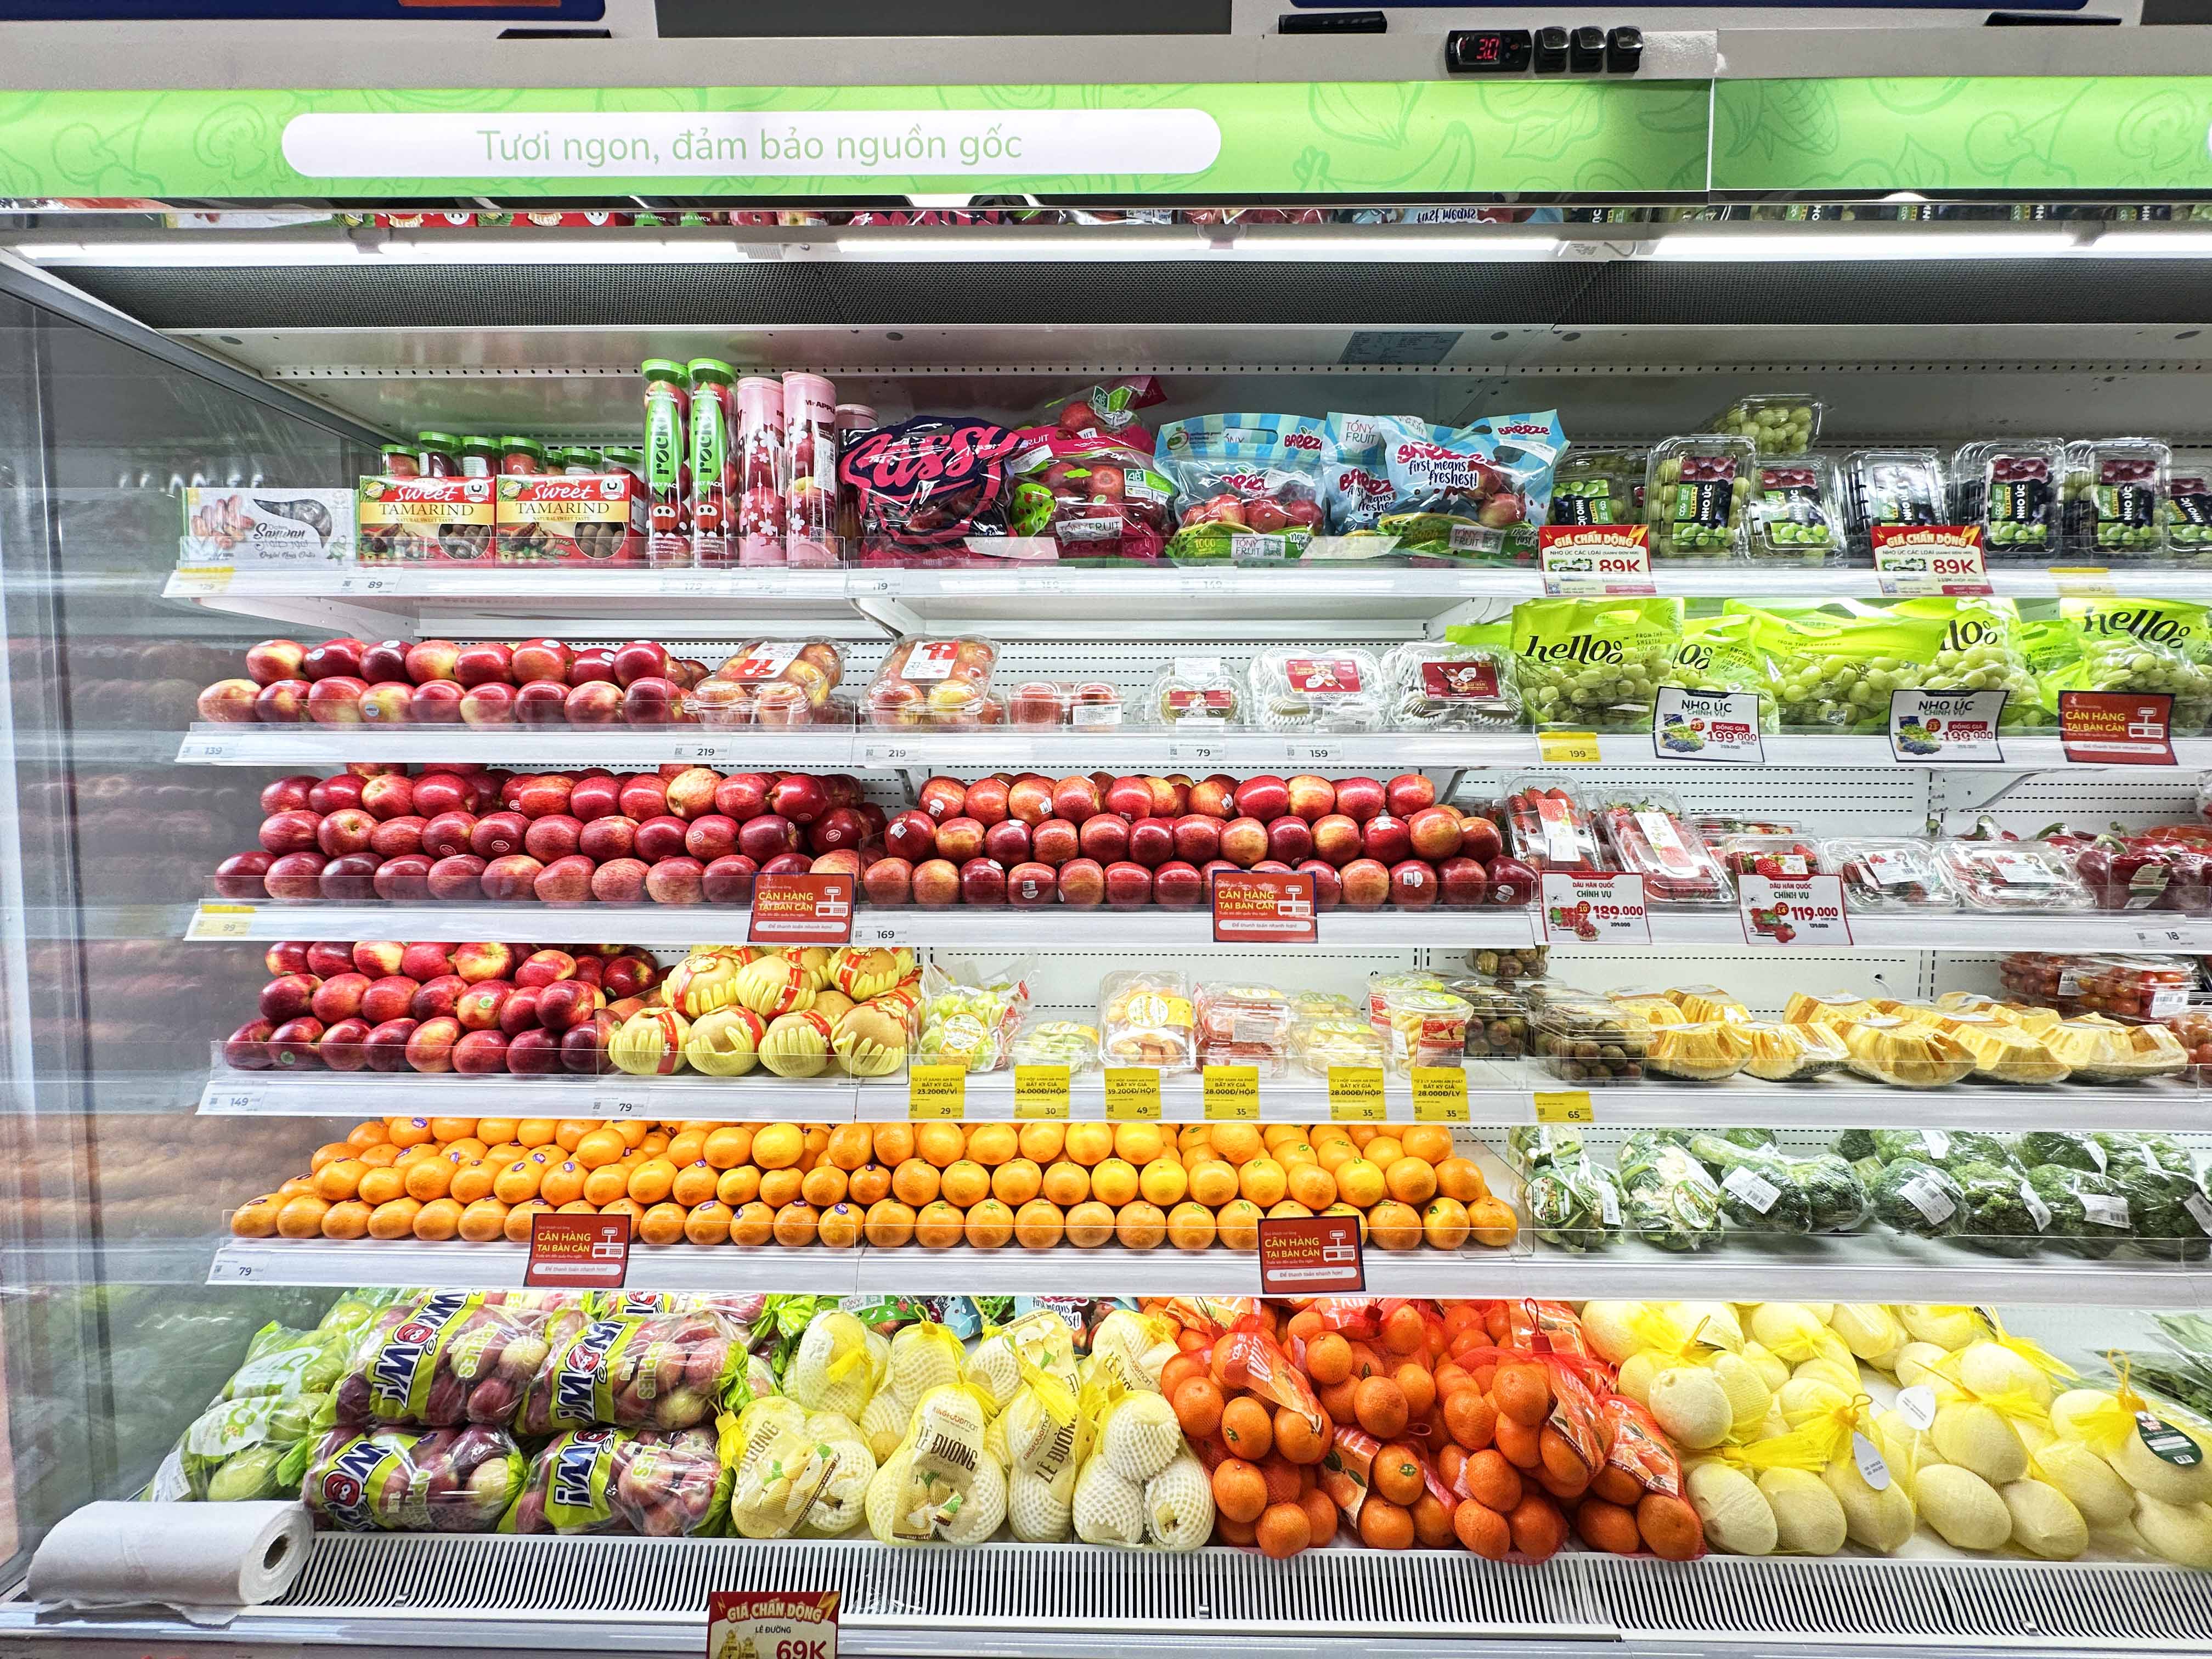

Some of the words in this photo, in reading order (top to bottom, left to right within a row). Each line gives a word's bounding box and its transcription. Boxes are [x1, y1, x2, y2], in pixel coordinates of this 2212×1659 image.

[477, 129, 551, 161] Tươi
[564, 132, 661, 168] ngon,
[672, 127, 748, 161] đảm
[760, 127, 823, 161] bảo
[837, 123, 946, 167] nguồn
[958, 122, 1022, 166] gốc
[1346, 420, 1375, 433] TÓNY
[1346, 432, 1375, 444] FRUIT
[1408, 459, 1431, 476] first
[1434, 460, 1467, 472] means
[1428, 470, 1478, 487] freshest!
[1701, 484, 1713, 499] ÚC
[2015, 484, 2025, 498] ÚC
[2123, 485, 2133, 499] ÚC
[379, 504, 475, 516] TAMARIND
[515, 502, 610, 515] TAMARIND
[1575, 499, 1584, 515] NHO
[1701, 500, 1710, 521] NHO
[2016, 498, 2025, 519] NHO
[2124, 499, 2133, 521] NHO
[1454, 537, 1480, 547] FRUIT
[1554, 533, 1573, 548] GIÁ
[1574, 531, 1603, 546] CHẤN
[1603, 532, 1634, 548] ĐỘNG
[1886, 532, 1906, 548] GIÁ
[1906, 529, 1936, 545] CHẤN
[1936, 532, 1967, 548] ĐỘNG
[1235, 548, 1260, 556] FRUIT
[1599, 558, 1640, 572] 89K
[1932, 558, 1977, 575] 89K
[367, 581, 383, 589] 89
[1681, 699, 1710, 710] NHO
[1714, 699, 1733, 713] ÚC
[1918, 701, 1950, 711] NHO
[1954, 698, 1975, 711] ÚC
[2065, 709, 2089, 721] CÂN
[2092, 709, 2125, 721] HÀNG
[2083, 721, 2103, 731] BÀN
[2106, 723, 2125, 732] CÂN
[697, 747, 715, 757] 219
[888, 748, 907, 758] 219
[1196, 749, 1211, 758] 79
[1309, 749, 1329, 758] 159
[1568, 749, 1587, 759] 199
[758, 890, 781, 901] CÂN
[783, 890, 814, 901] HÀNG
[1218, 888, 1241, 899] CÂN
[1243, 888, 1274, 900] HÀNG
[1576, 889, 1600, 898] CHÍNH
[1601, 890, 1612, 899] VỤ
[1773, 890, 1797, 899] CHÍNH
[1798, 892, 1809, 900] VỤ
[1218, 902, 1233, 911] TẠI
[1235, 900, 1254, 910] BÀN
[1256, 901, 1274, 910] CÂN
[1593, 905, 1644, 920] 189.000
[1791, 906, 1838, 921] 119.000
[877, 930, 895, 939] 169
[2165, 932, 2180, 941] 18
[229, 1098, 249, 1107] 149
[618, 1103, 633, 1112] 79
[1136, 1106, 1148, 1114] 49
[1567, 1111, 1580, 1119] 65
[537, 1230, 558, 1242] CÂN
[561, 1230, 591, 1242] HÀNG
[1265, 1237, 1286, 1248] CÂN
[1289, 1235, 1320, 1246] HÀNG
[537, 1244, 550, 1254] TẠI
[552, 1243, 570, 1252] BÀN
[572, 1244, 590, 1252] CÂN
[1265, 1250, 1279, 1260] TẠI
[1282, 1248, 1300, 1258] BÀN
[1302, 1249, 1321, 1257] CÂN
[238, 1267, 252, 1276] 79
[374, 1288, 468, 1409] WOW!
[555, 1319, 629, 1423] WOW!
[1034, 1460, 1058, 1484] LÊ
[727, 1601, 751, 1622] GIÁ
[751, 1598, 786, 1618] CHẤN
[786, 1601, 823, 1623] ĐỘNG
[765, 1625, 792, 1634] ĐƯỜNG
[776, 1640, 827, 1659] 69K
